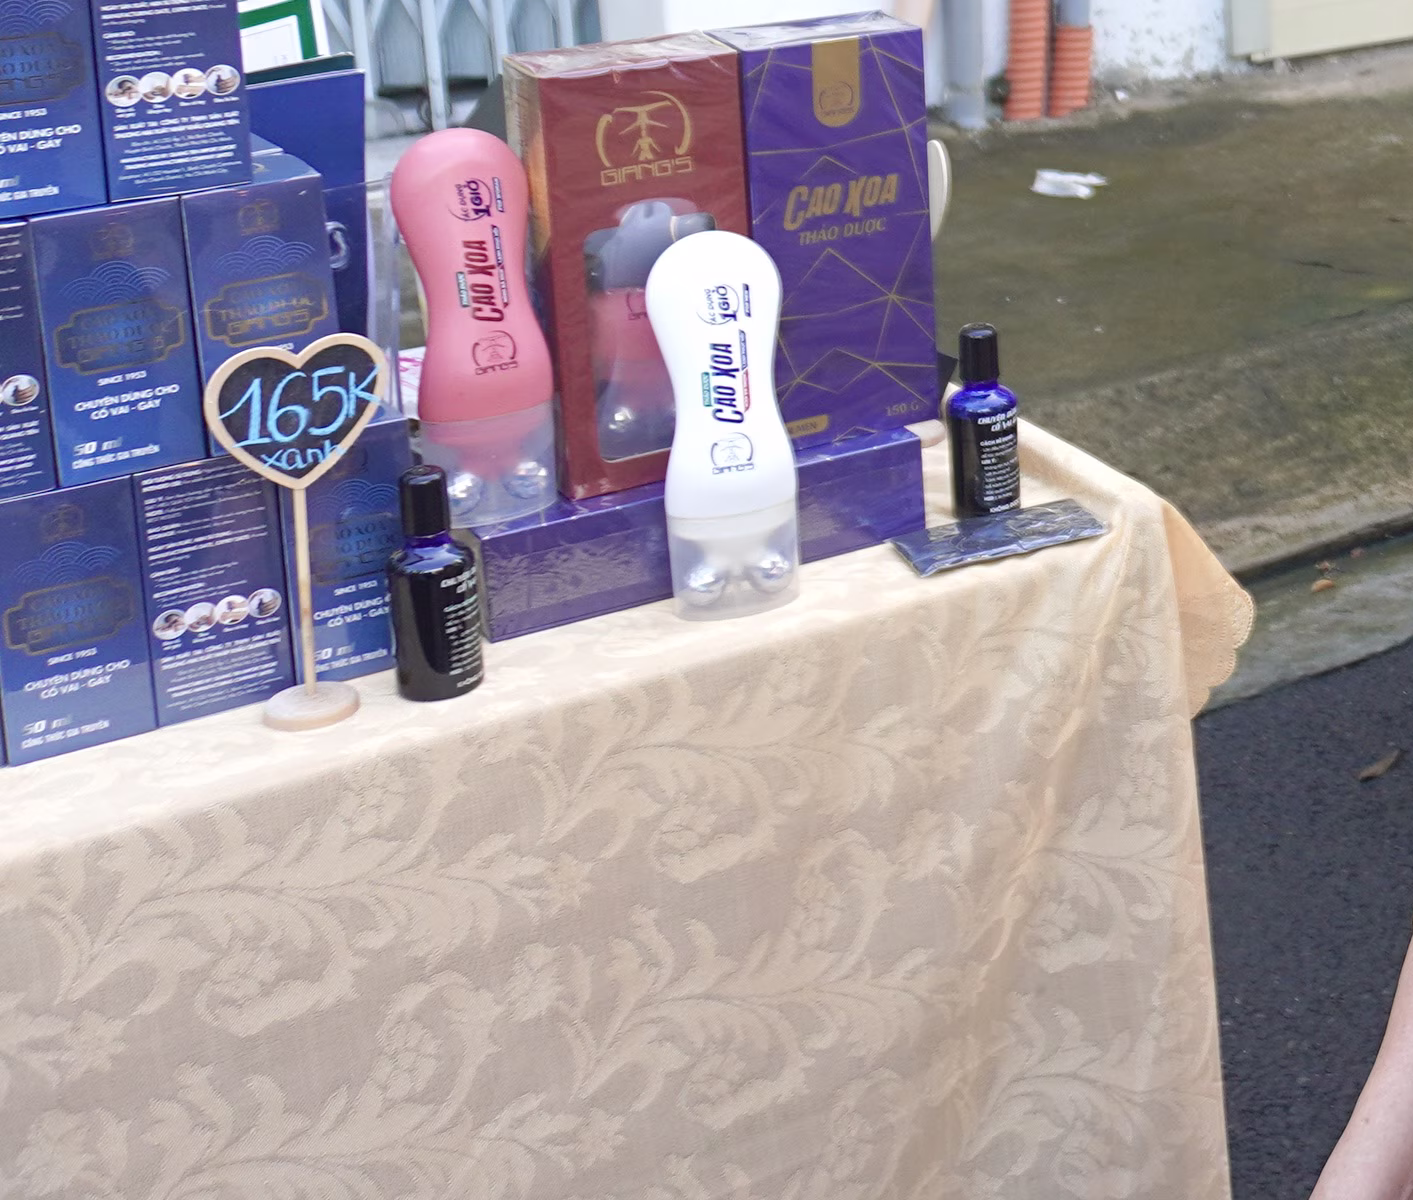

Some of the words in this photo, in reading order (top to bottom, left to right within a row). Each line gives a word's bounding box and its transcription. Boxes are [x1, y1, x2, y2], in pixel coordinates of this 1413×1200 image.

[601, 156, 693, 186] GIANG'S
[783, 183, 841, 231] CAO
[843, 173, 899, 216] XOA
[798, 226, 839, 246] THẢO
[842, 216, 887, 239] DƯỢC
[461, 240, 496, 277] XOA
[468, 283, 504, 322] CAO
[709, 342, 739, 378] XOA
[711, 385, 744, 424] CAO
